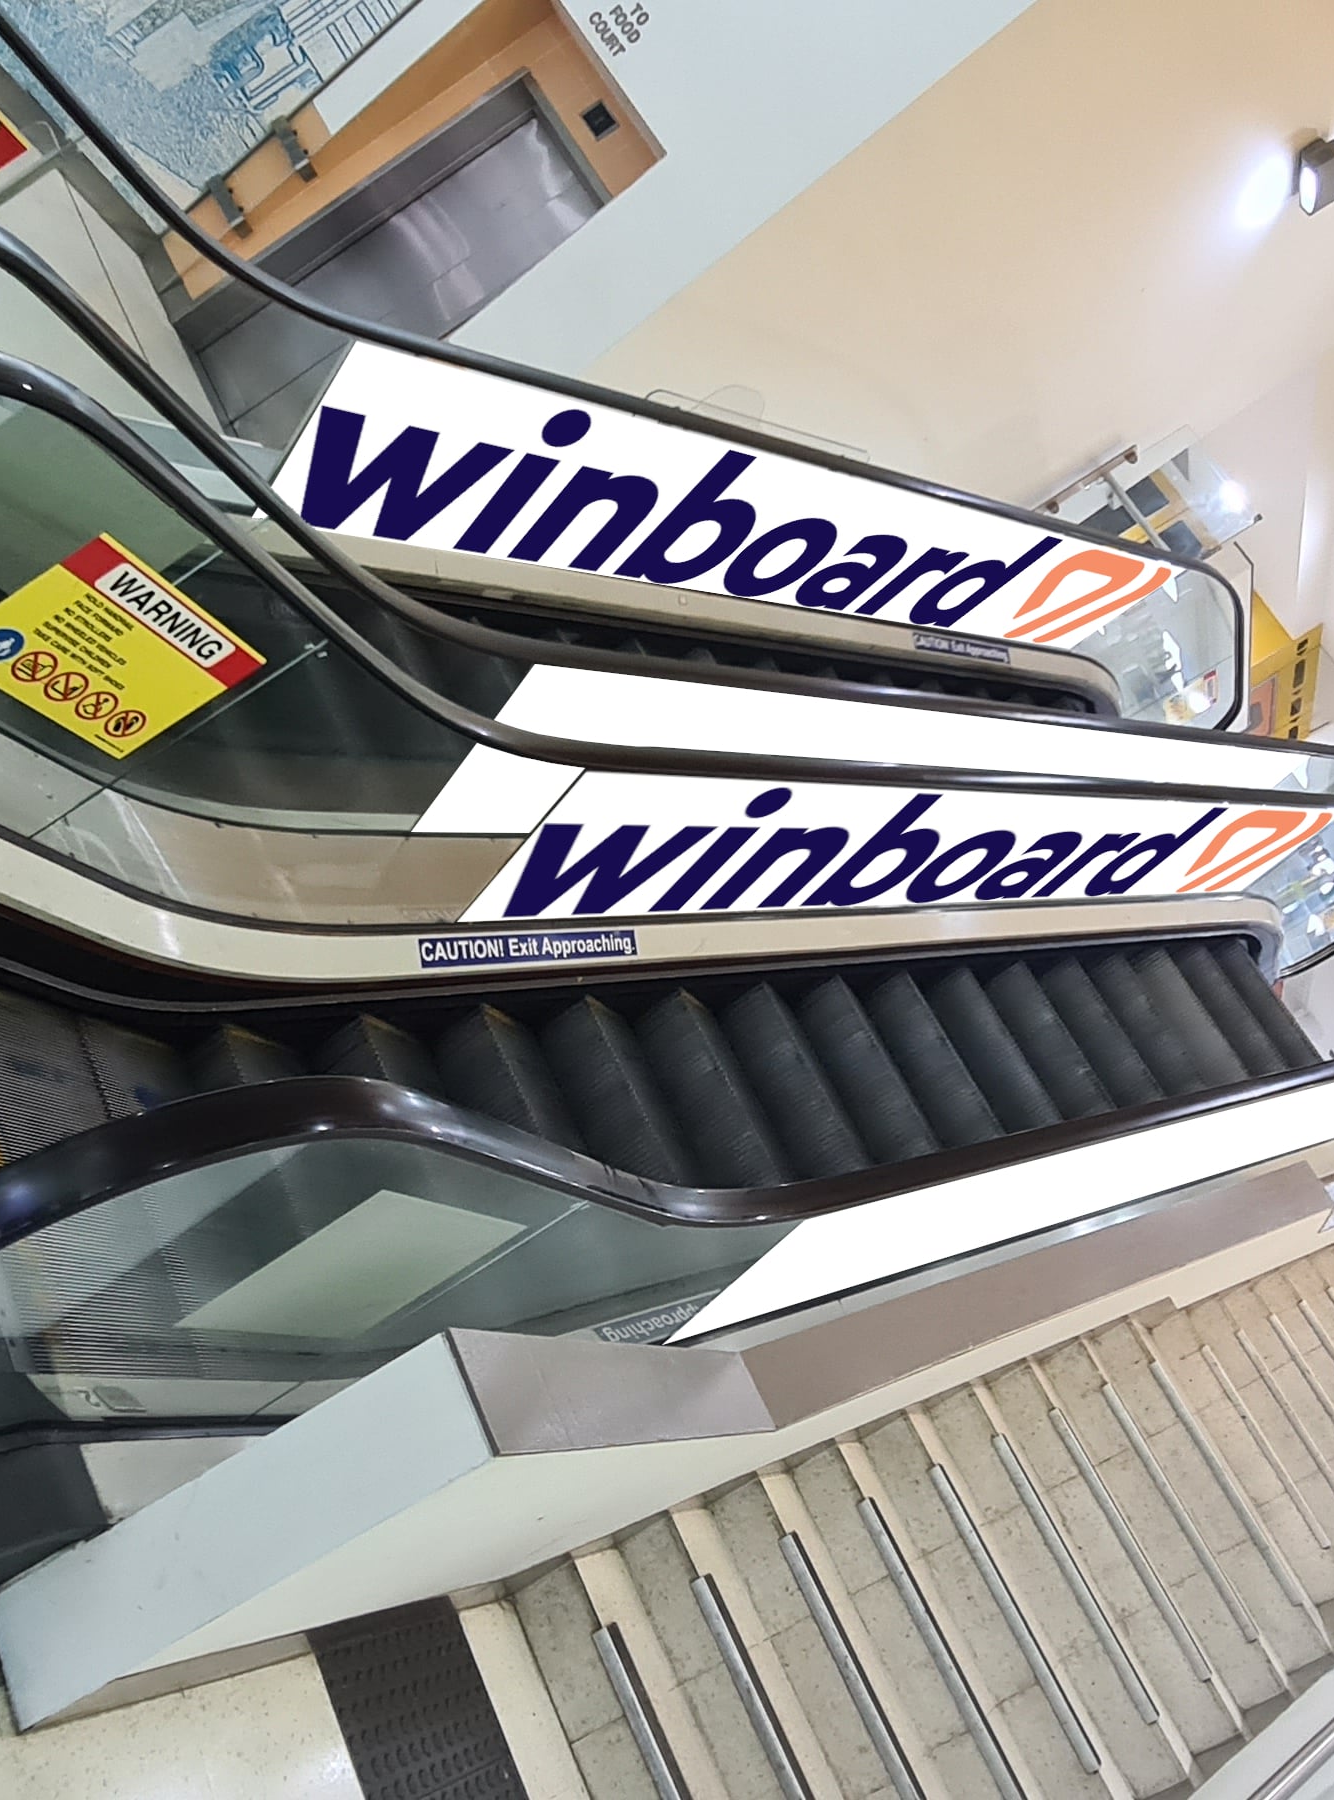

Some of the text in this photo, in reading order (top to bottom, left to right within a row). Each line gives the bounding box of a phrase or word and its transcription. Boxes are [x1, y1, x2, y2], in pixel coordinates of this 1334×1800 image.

[589, 11, 626, 57] COURT
[610, 4, 641, 44] FOOD
[630, 3, 650, 26] TO
[302, 407, 1060, 627] winboard
[108, 570, 223, 660] WARNING
[506, 788, 1224, 912] winboard
[421, 934, 636, 962] CAUTION! Exit Approaching.
